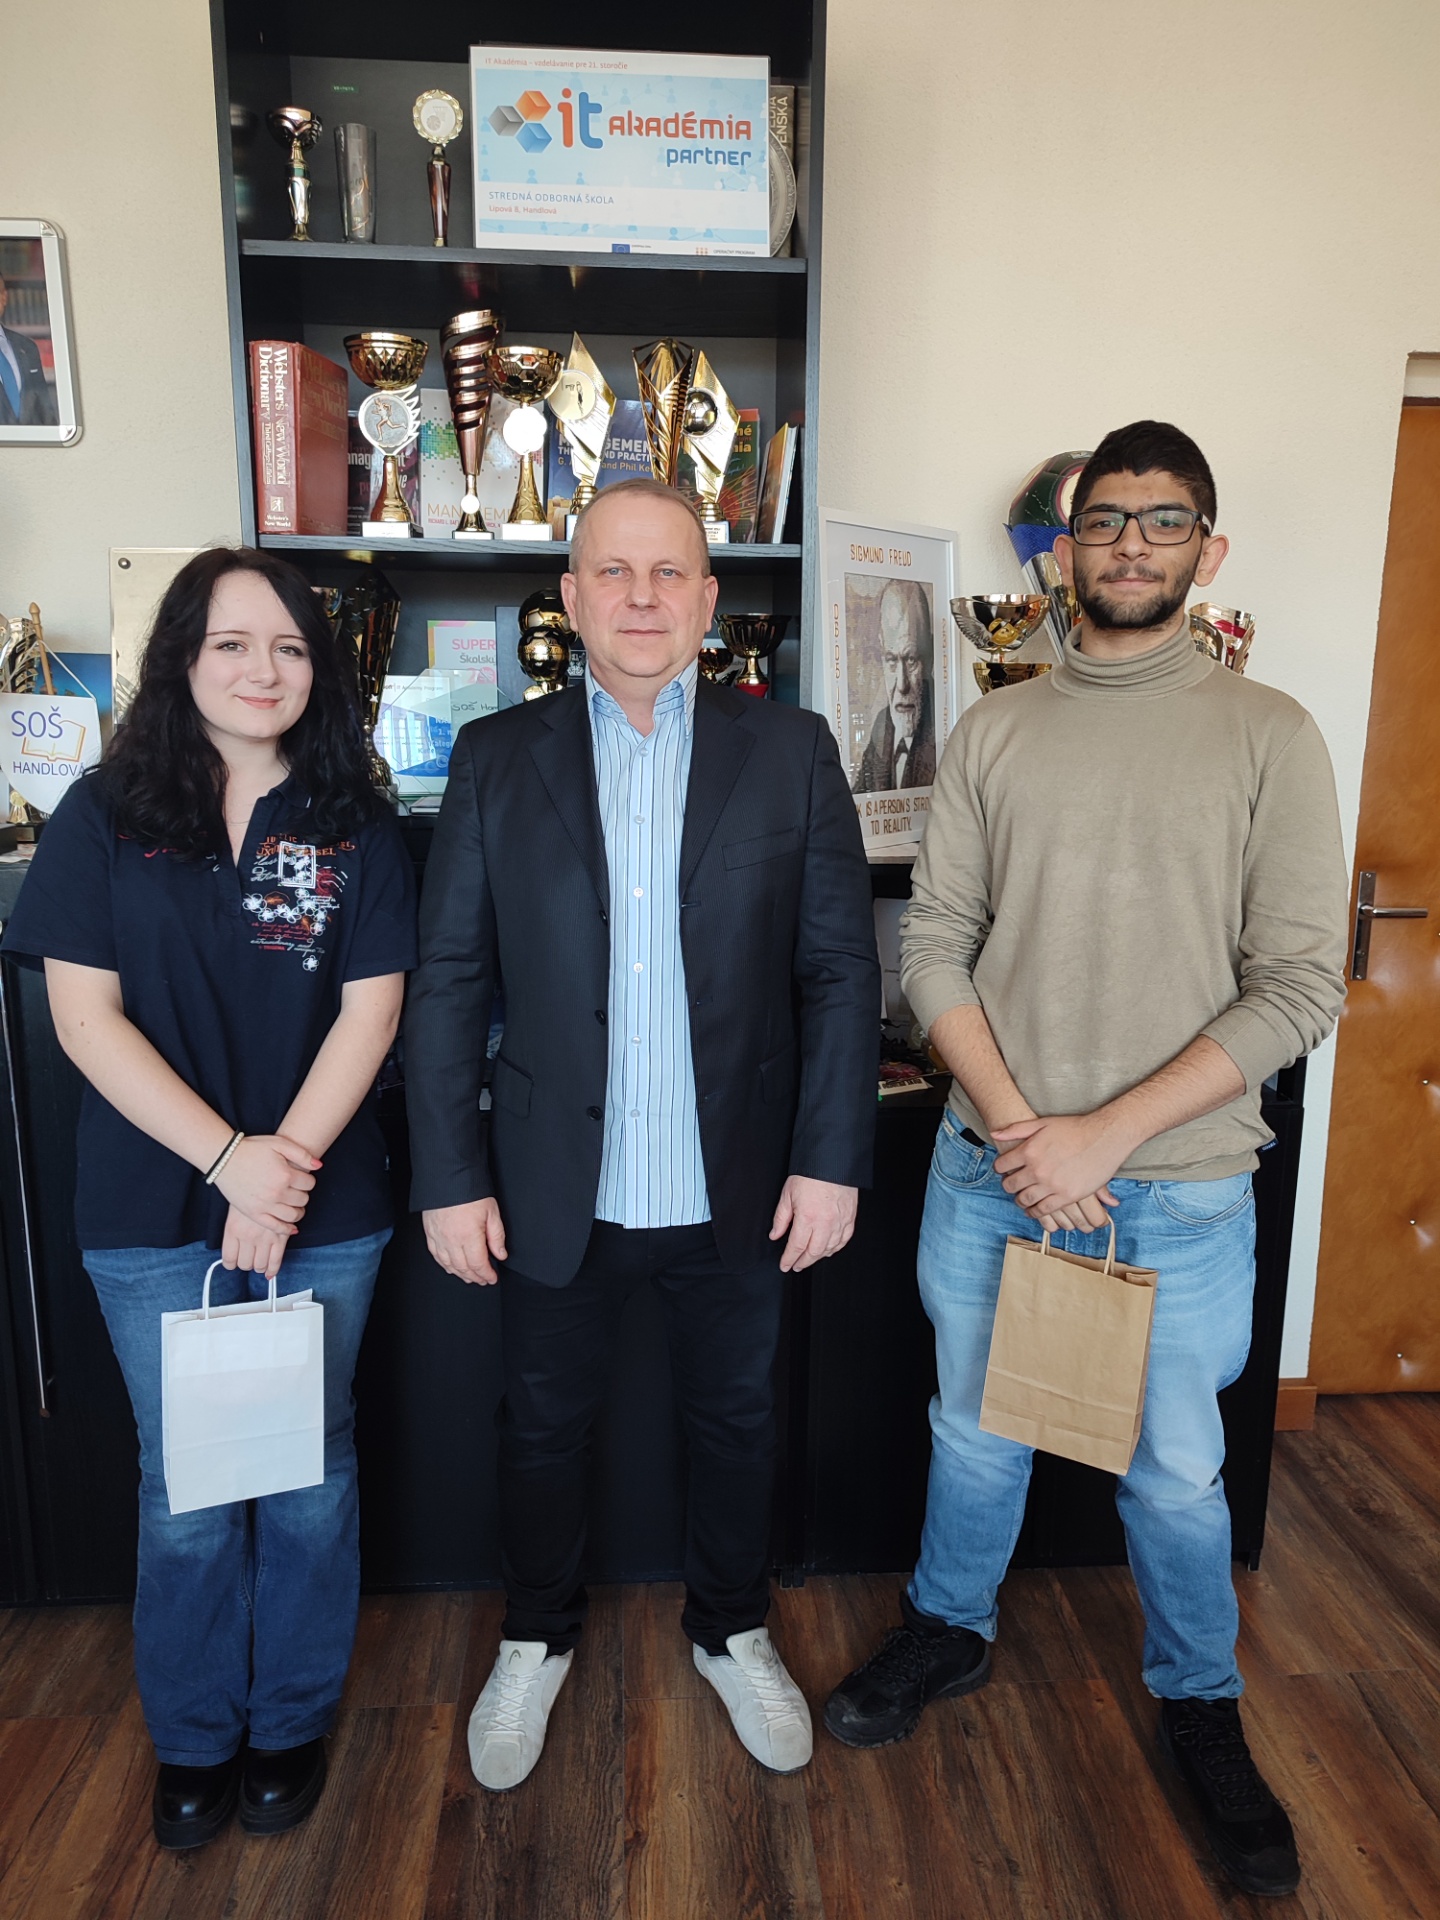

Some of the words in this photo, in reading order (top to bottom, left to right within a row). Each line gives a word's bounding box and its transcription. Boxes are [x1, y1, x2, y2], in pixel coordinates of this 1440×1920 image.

[493, 58, 528, 66] Akadémia
[557, 87, 604, 149] it
[777, 96, 788, 144] ENSKA
[666, 147, 752, 167] partner
[488, 191, 532, 201] STREDNÁ
[535, 193, 582, 203] ODBORNÁ
[585, 194, 614, 204] ŠKOLA
[489, 205, 512, 213] Lipová
[523, 206, 557, 214] Handlová
[276, 442, 291, 487] World
[617, 451, 651, 463] PRACTI
[620, 461, 636, 472] Phil
[850, 543, 883, 564] SIGMUND
[889, 548, 912, 567] FREUD
[11, 705, 63, 739] SOŠ
[871, 820, 880, 835] TO
